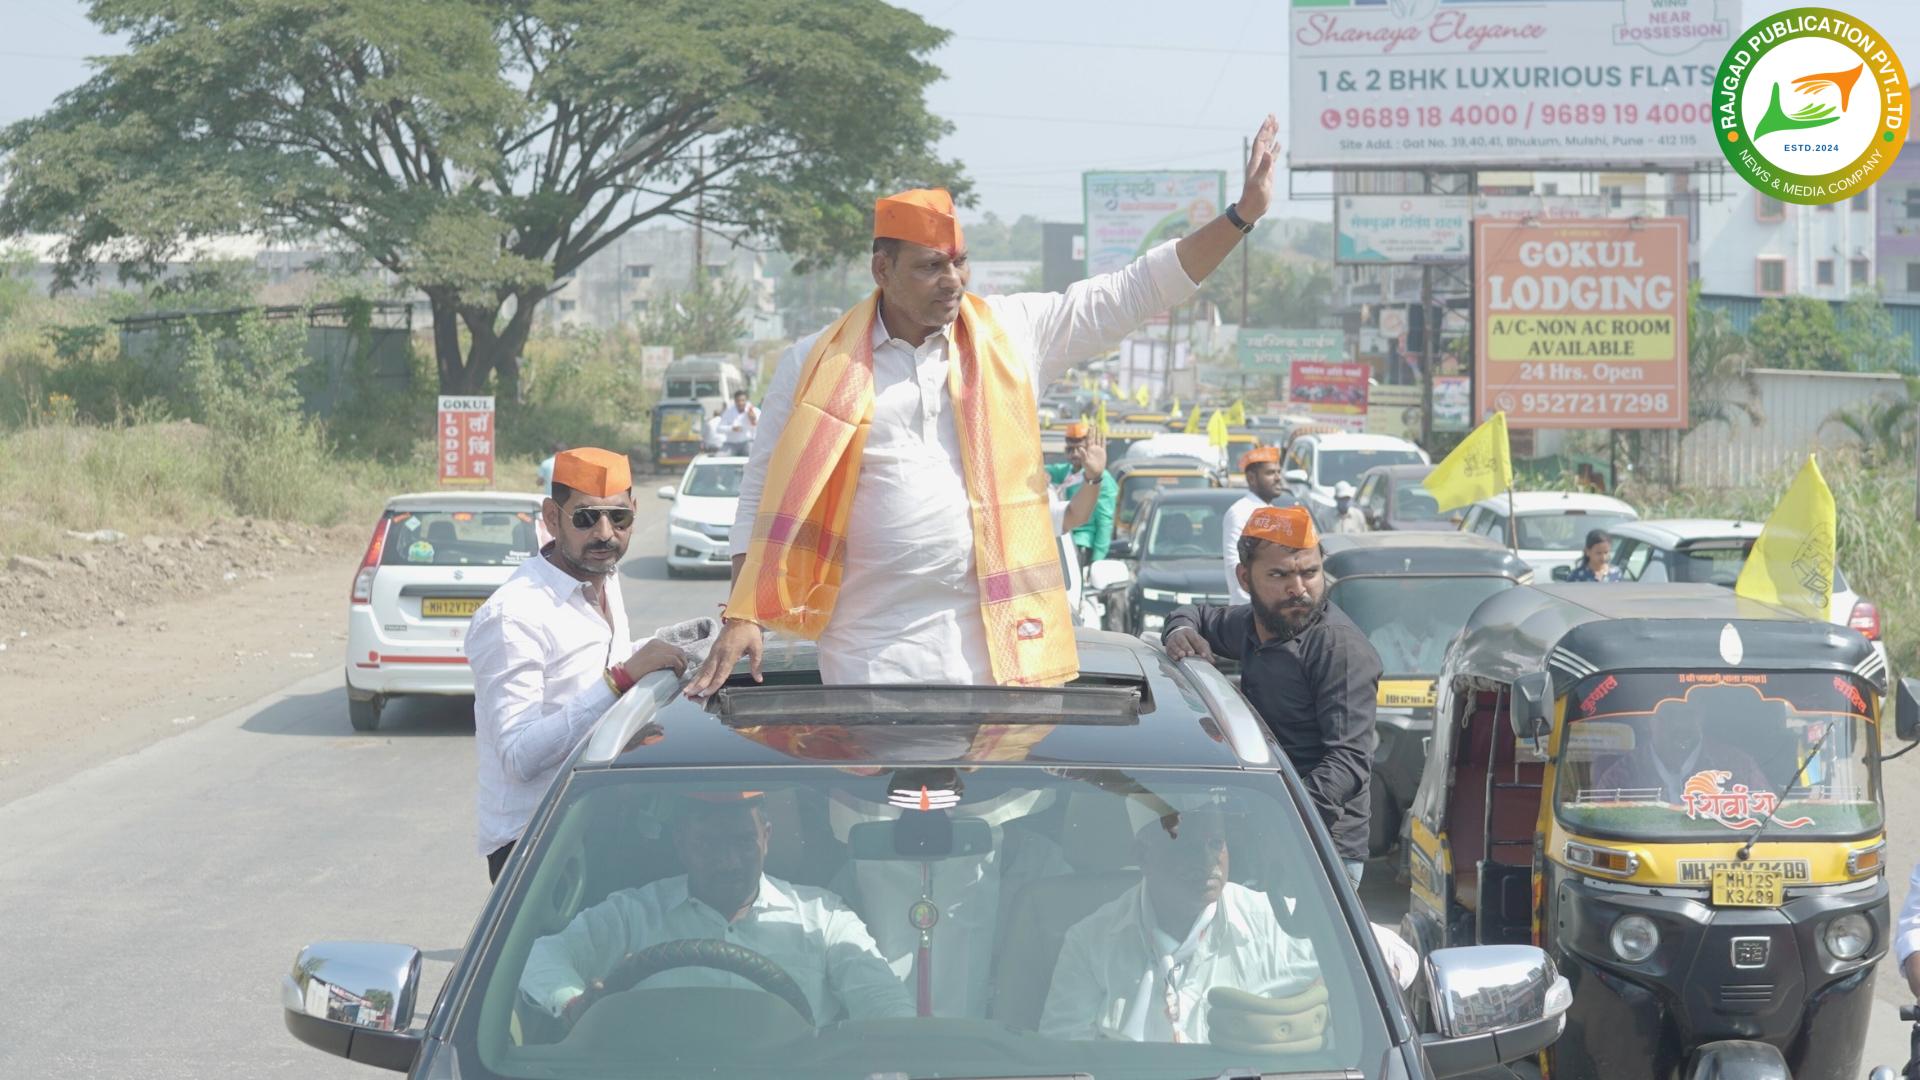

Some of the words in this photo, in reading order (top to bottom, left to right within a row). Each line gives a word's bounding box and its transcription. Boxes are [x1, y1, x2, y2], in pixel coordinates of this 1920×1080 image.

[1649, 11, 1691, 25] NEAR
[1296, 13, 1421, 53] Shanaya
[1428, 10, 1546, 51] Elegance
[1619, 25, 1723, 41] POSSESSION
[1318, 70, 1328, 92] 1
[1337, 70, 1357, 92] &
[1366, 69, 1381, 91] 2
[1389, 68, 1447, 91] BHK
[1456, 65, 1622, 90] LUXURIOUS
[1630, 65, 1716, 88] FLATS
[1345, 107, 1409, 129] 9689
[1417, 106, 1442, 128] 18
[1450, 104, 1517, 127] 4000
[1524, 101, 1534, 130] /
[1541, 104, 1606, 126] 9689
[1613, 104, 1638, 125] 19
[1646, 103, 1712, 125] 4000
[1339, 139, 1362, 151] Site
[1366, 139, 1393, 150] Add.
[1402, 138, 1425, 150] Gat
[1427, 138, 1448, 149] No.
[1506, 136, 1562, 148] Bhukum,
[1565, 135, 1609, 148] Mulshi,
[1612, 135, 1644, 147] Pune
[1657, 135, 1676, 147] 412
[1680, 135, 1697, 146] 115
[1519, 241, 1643, 268] GOKUL
[1488, 275, 1674, 311] LODGING
[1492, 319, 1577, 336] A/C-NON
[1581, 319, 1607, 335] AC
[1611, 319, 1671, 335] ROOM
[1527, 340, 1635, 356] AVAILABLE
[1520, 364, 1544, 380] 24
[1549, 364, 1587, 380] Hrs.
[1593, 364, 1643, 383] Open
[443, 400, 491, 409] GOKUL
[1521, 393, 1669, 413] 9527217298
[445, 413, 459, 476] LODGE
[1726, 873, 1774, 888] MH12S
[1726, 890, 1774, 904] K3489
